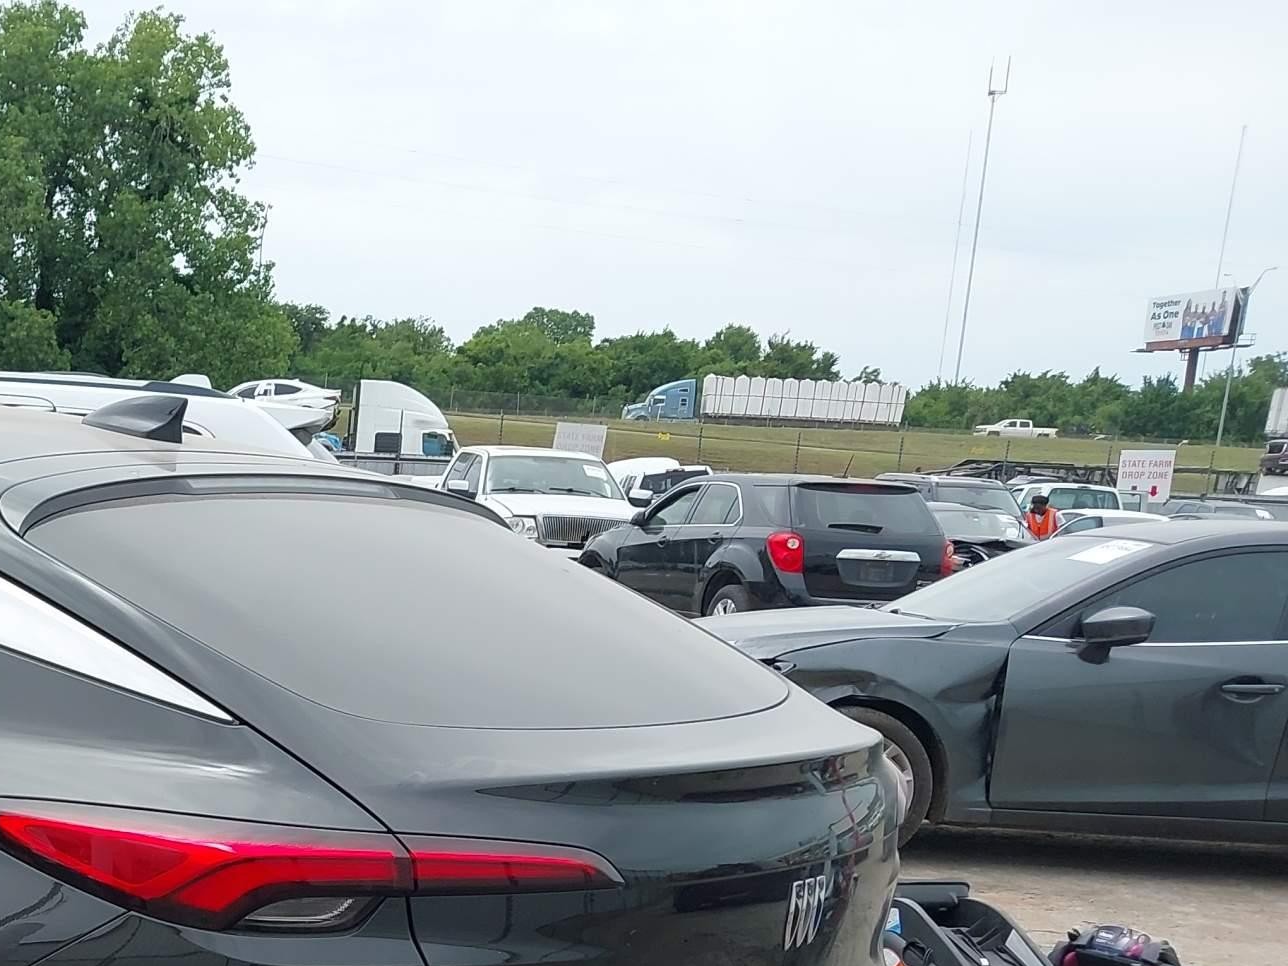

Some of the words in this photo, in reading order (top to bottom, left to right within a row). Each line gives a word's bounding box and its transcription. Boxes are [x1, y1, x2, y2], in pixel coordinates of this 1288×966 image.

[1152, 300, 1181, 310] Together
[1150, 312, 1162, 320] As
[1163, 310, 1179, 319] One
[1121, 460, 1145, 468] STATE
[1148, 460, 1172, 468] FARM
[1121, 471, 1145, 479] DROP
[1147, 471, 1169, 480] ZONE
